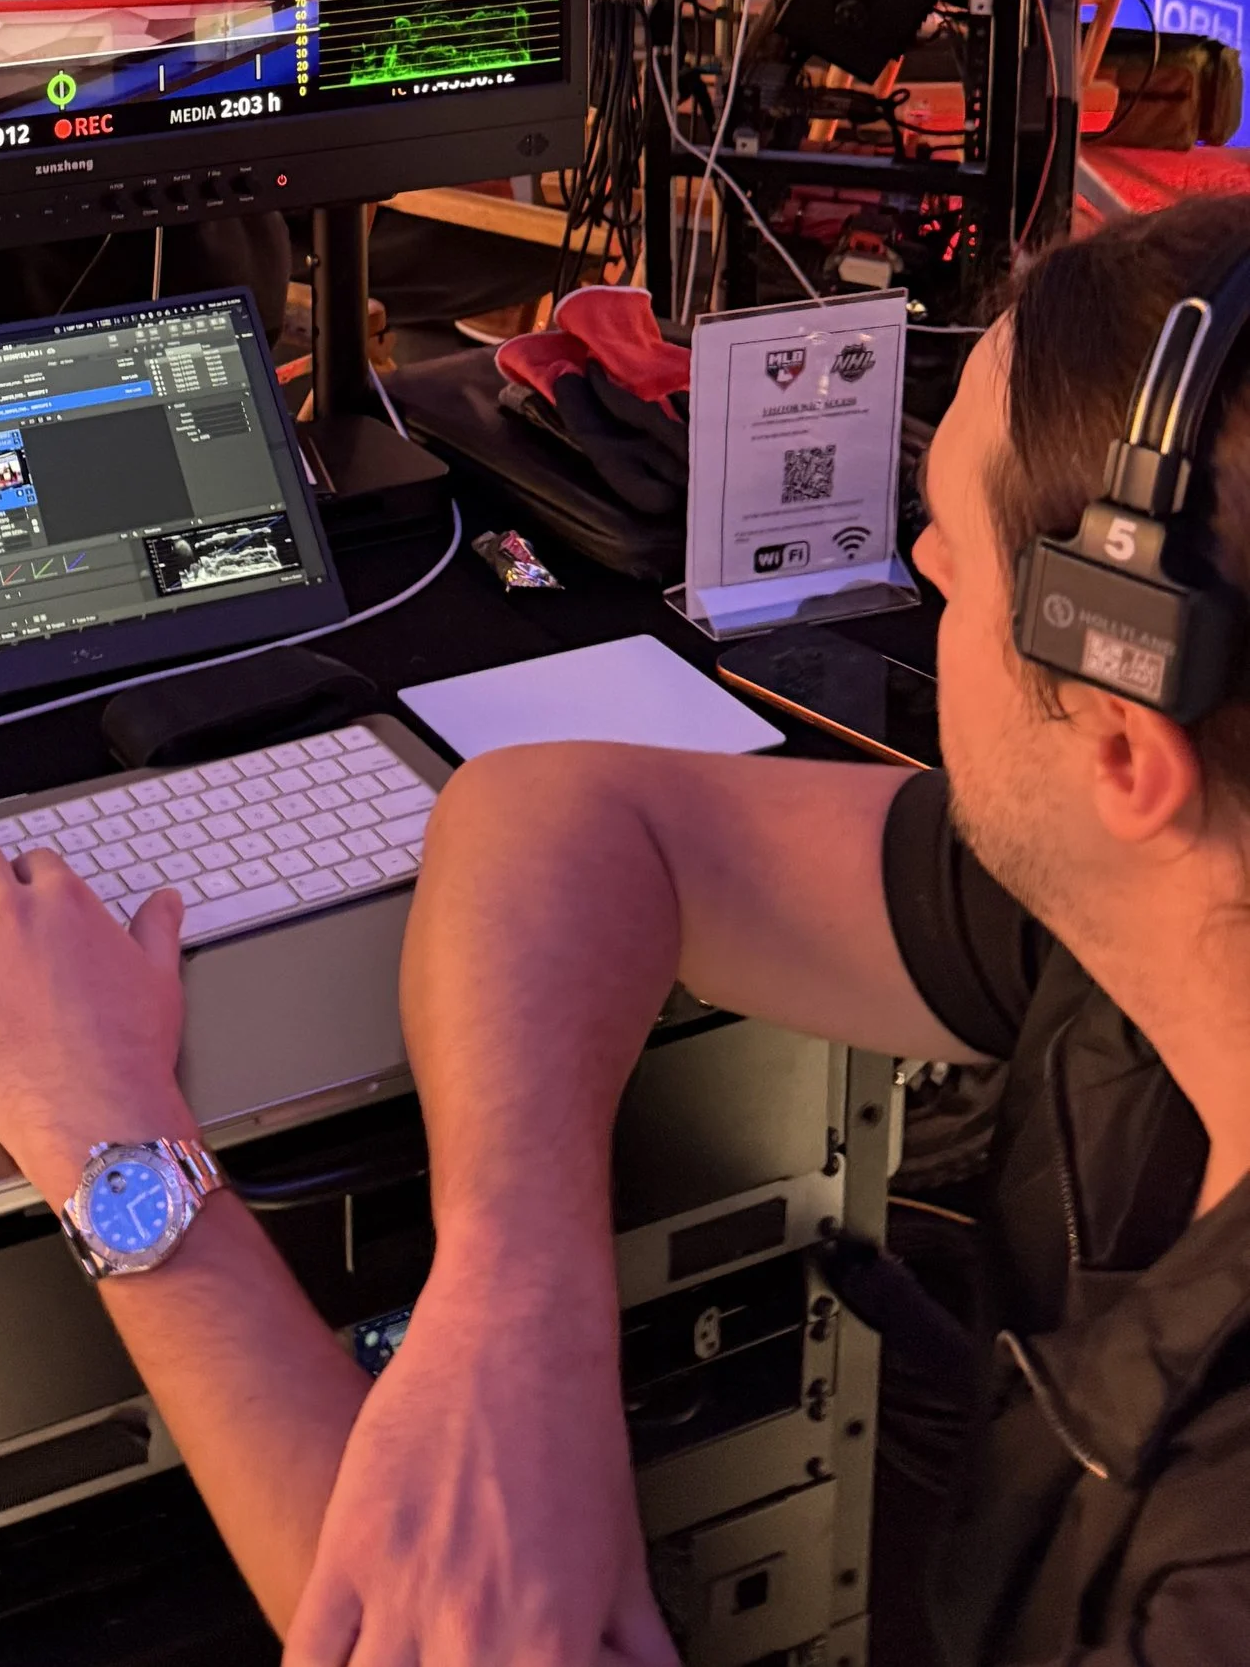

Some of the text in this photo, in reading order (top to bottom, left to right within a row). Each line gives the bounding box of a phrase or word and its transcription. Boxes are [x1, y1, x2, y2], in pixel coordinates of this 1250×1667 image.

[296, 35, 308, 46] 40
[296, 48, 308, 59] 30
[296, 61, 308, 72] 20
[296, 74, 308, 84] 10
[299, 87, 308, 97] 0
[170, 94, 281, 125] MEDIA 2:03 h
[74, 114, 113, 138] REC
[35, 158, 94, 175] zunzheng
[833, 350, 876, 371] NHL
[1103, 516, 1138, 560] 5
